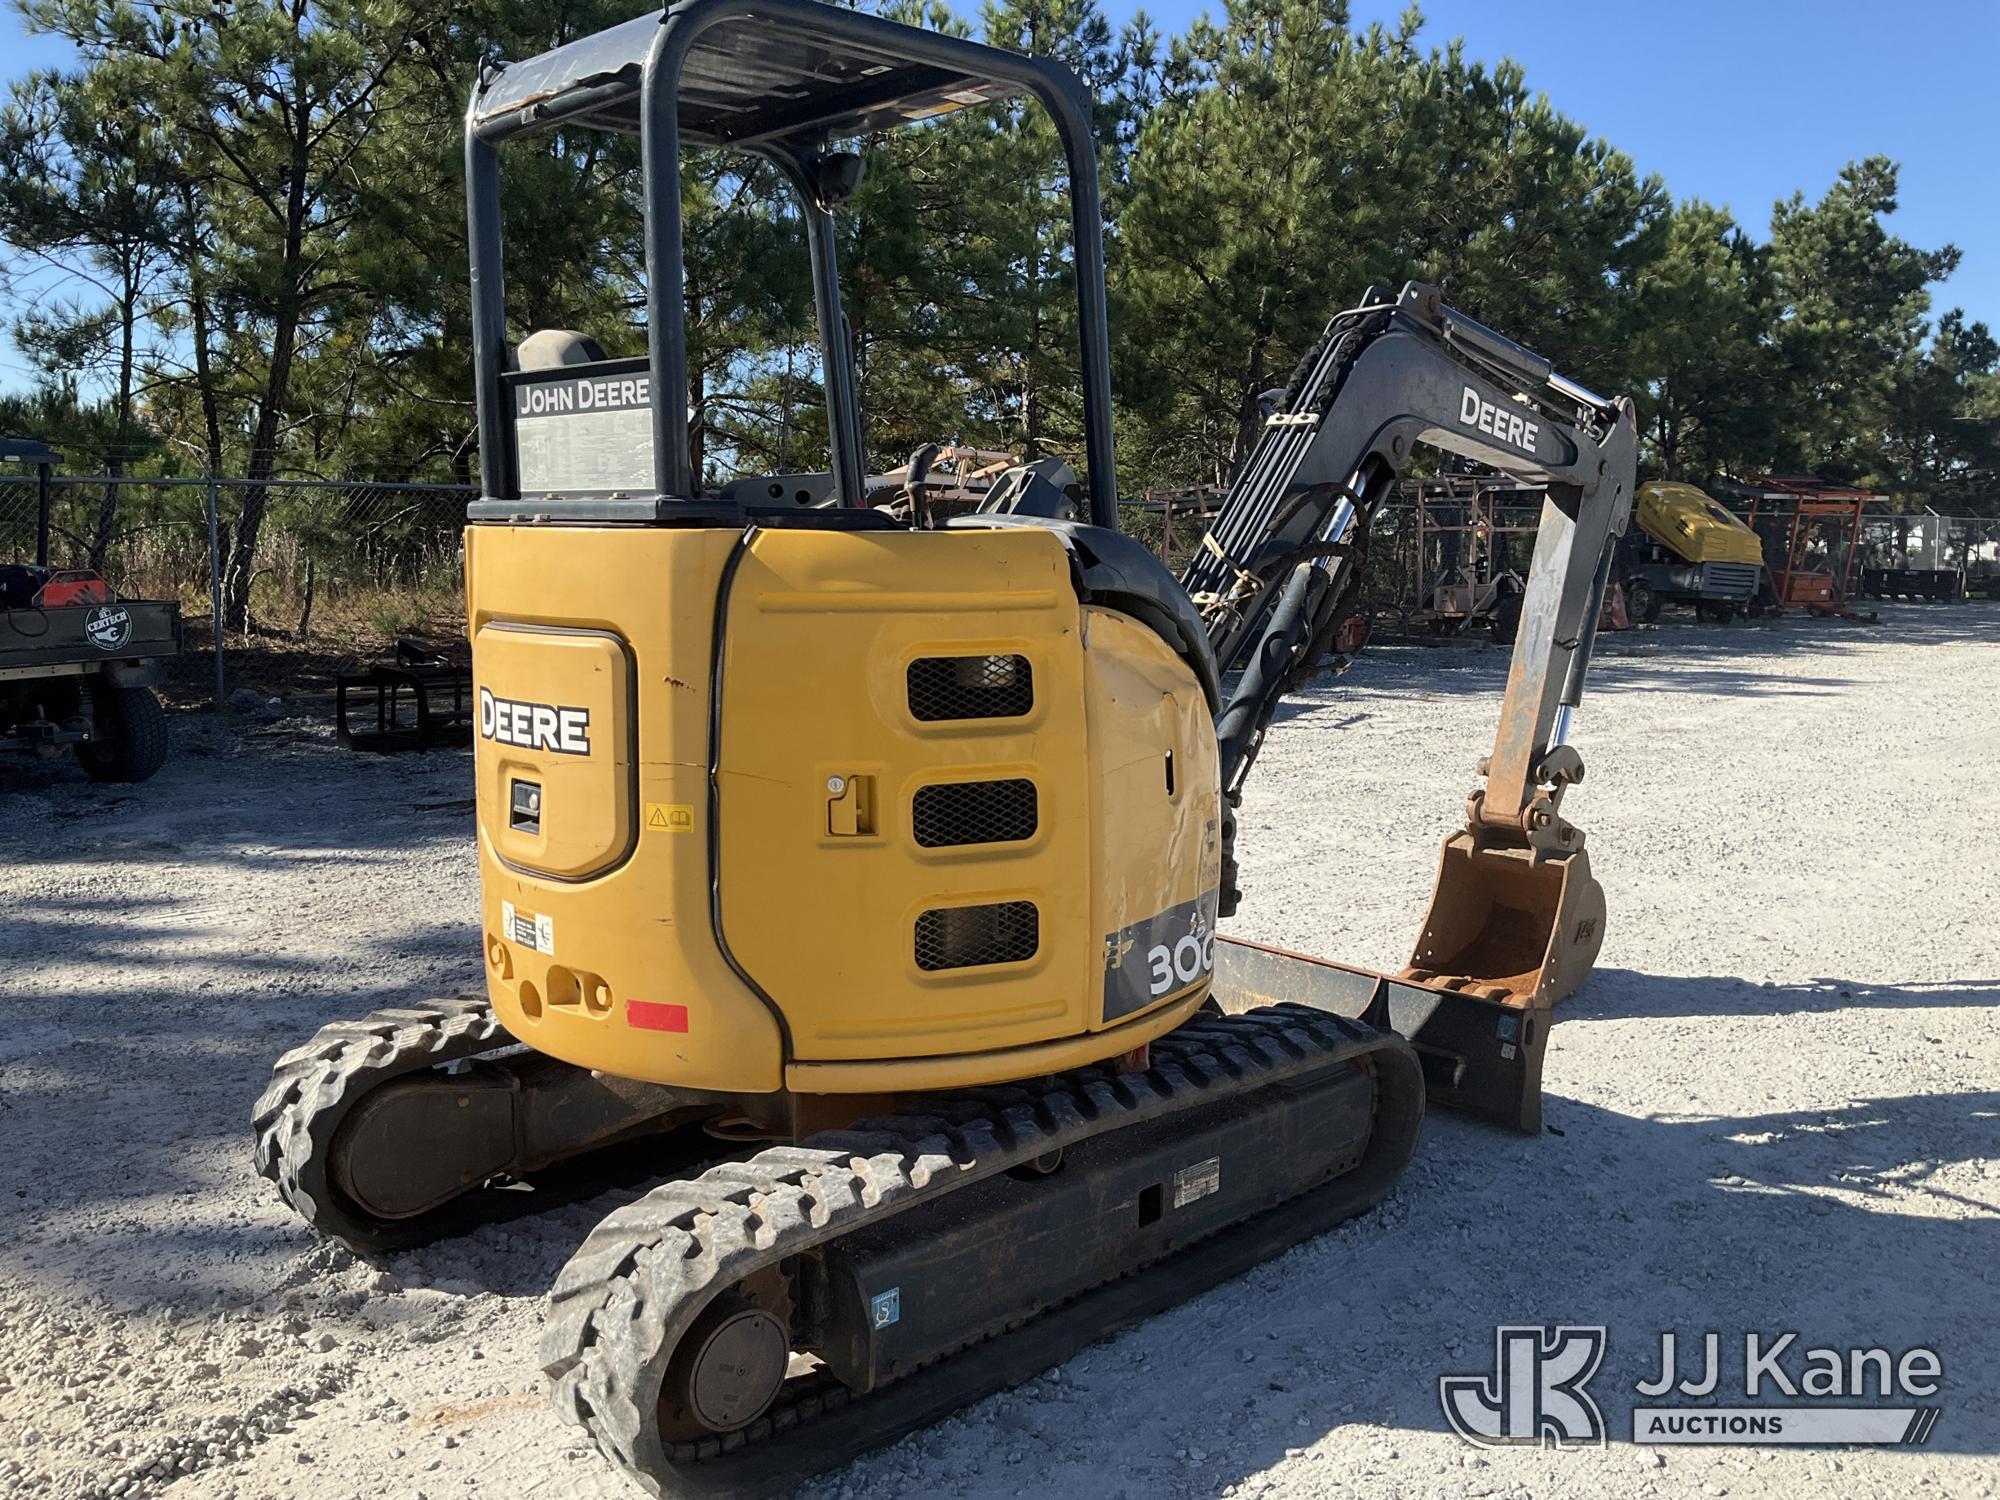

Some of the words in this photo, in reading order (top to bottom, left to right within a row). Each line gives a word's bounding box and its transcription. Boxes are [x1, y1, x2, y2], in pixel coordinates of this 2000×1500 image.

[520, 386, 573, 415] JOHN
[577, 378, 650, 409] DEERE
[1459, 386, 1539, 453] DEERE
[480, 686, 591, 756] DEERE
